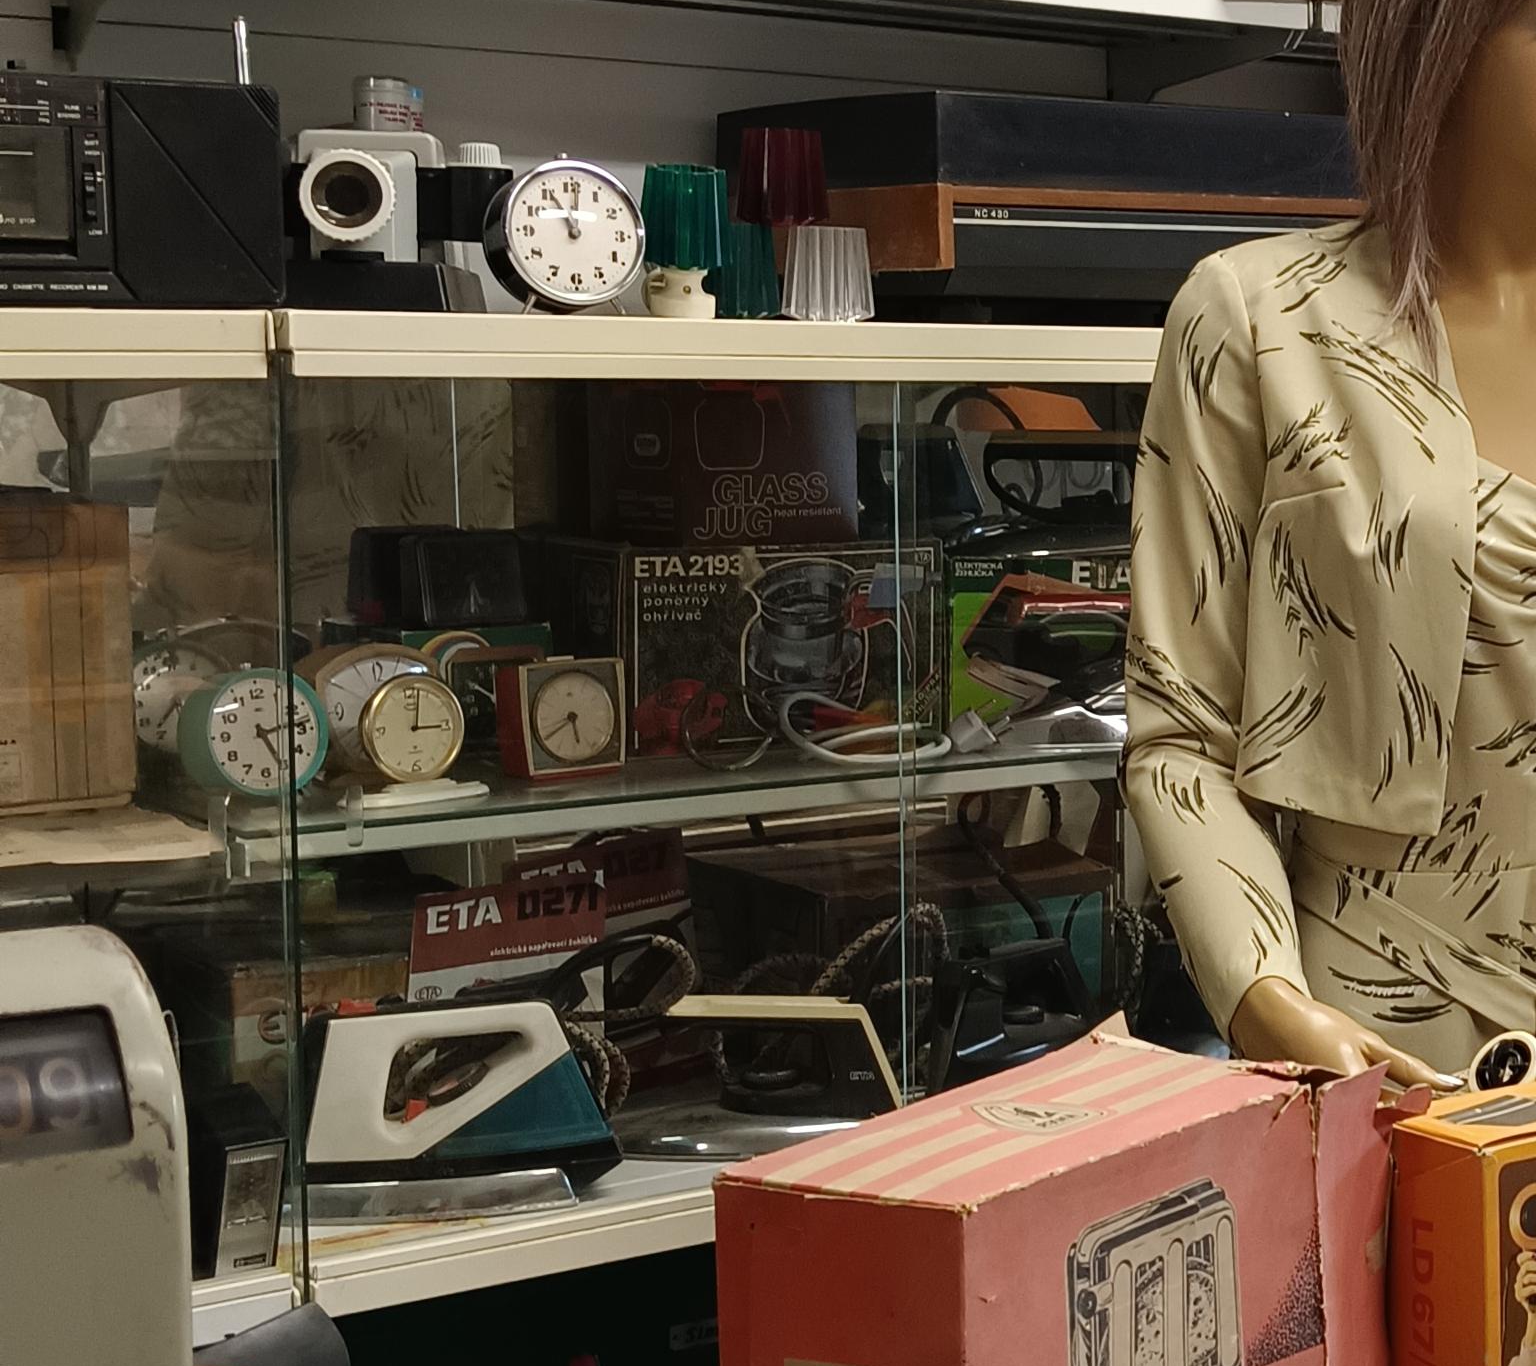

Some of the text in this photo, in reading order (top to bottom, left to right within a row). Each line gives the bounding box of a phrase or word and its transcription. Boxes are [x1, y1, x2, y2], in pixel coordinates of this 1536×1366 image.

[605, 206, 618, 221] 2
[521, 223, 536, 238] 9
[614, 229, 627, 244] 3
[570, 272, 583, 287] 6
[712, 472, 829, 507] GLASS
[693, 504, 773, 541] JUG
[634, 554, 742, 578] ETA 2193
[248, 688, 265, 701] 12
[221, 713, 238, 725] 10
[220, 731, 231, 743] 9
[227, 750, 239, 762] 8
[242, 763, 253, 775] 7
[260, 766, 271, 779] 6
[426, 894, 503, 937] ETA
[850, 1070, 875, 1081] ETA
[1412, 1217, 1435, 1285] LD
